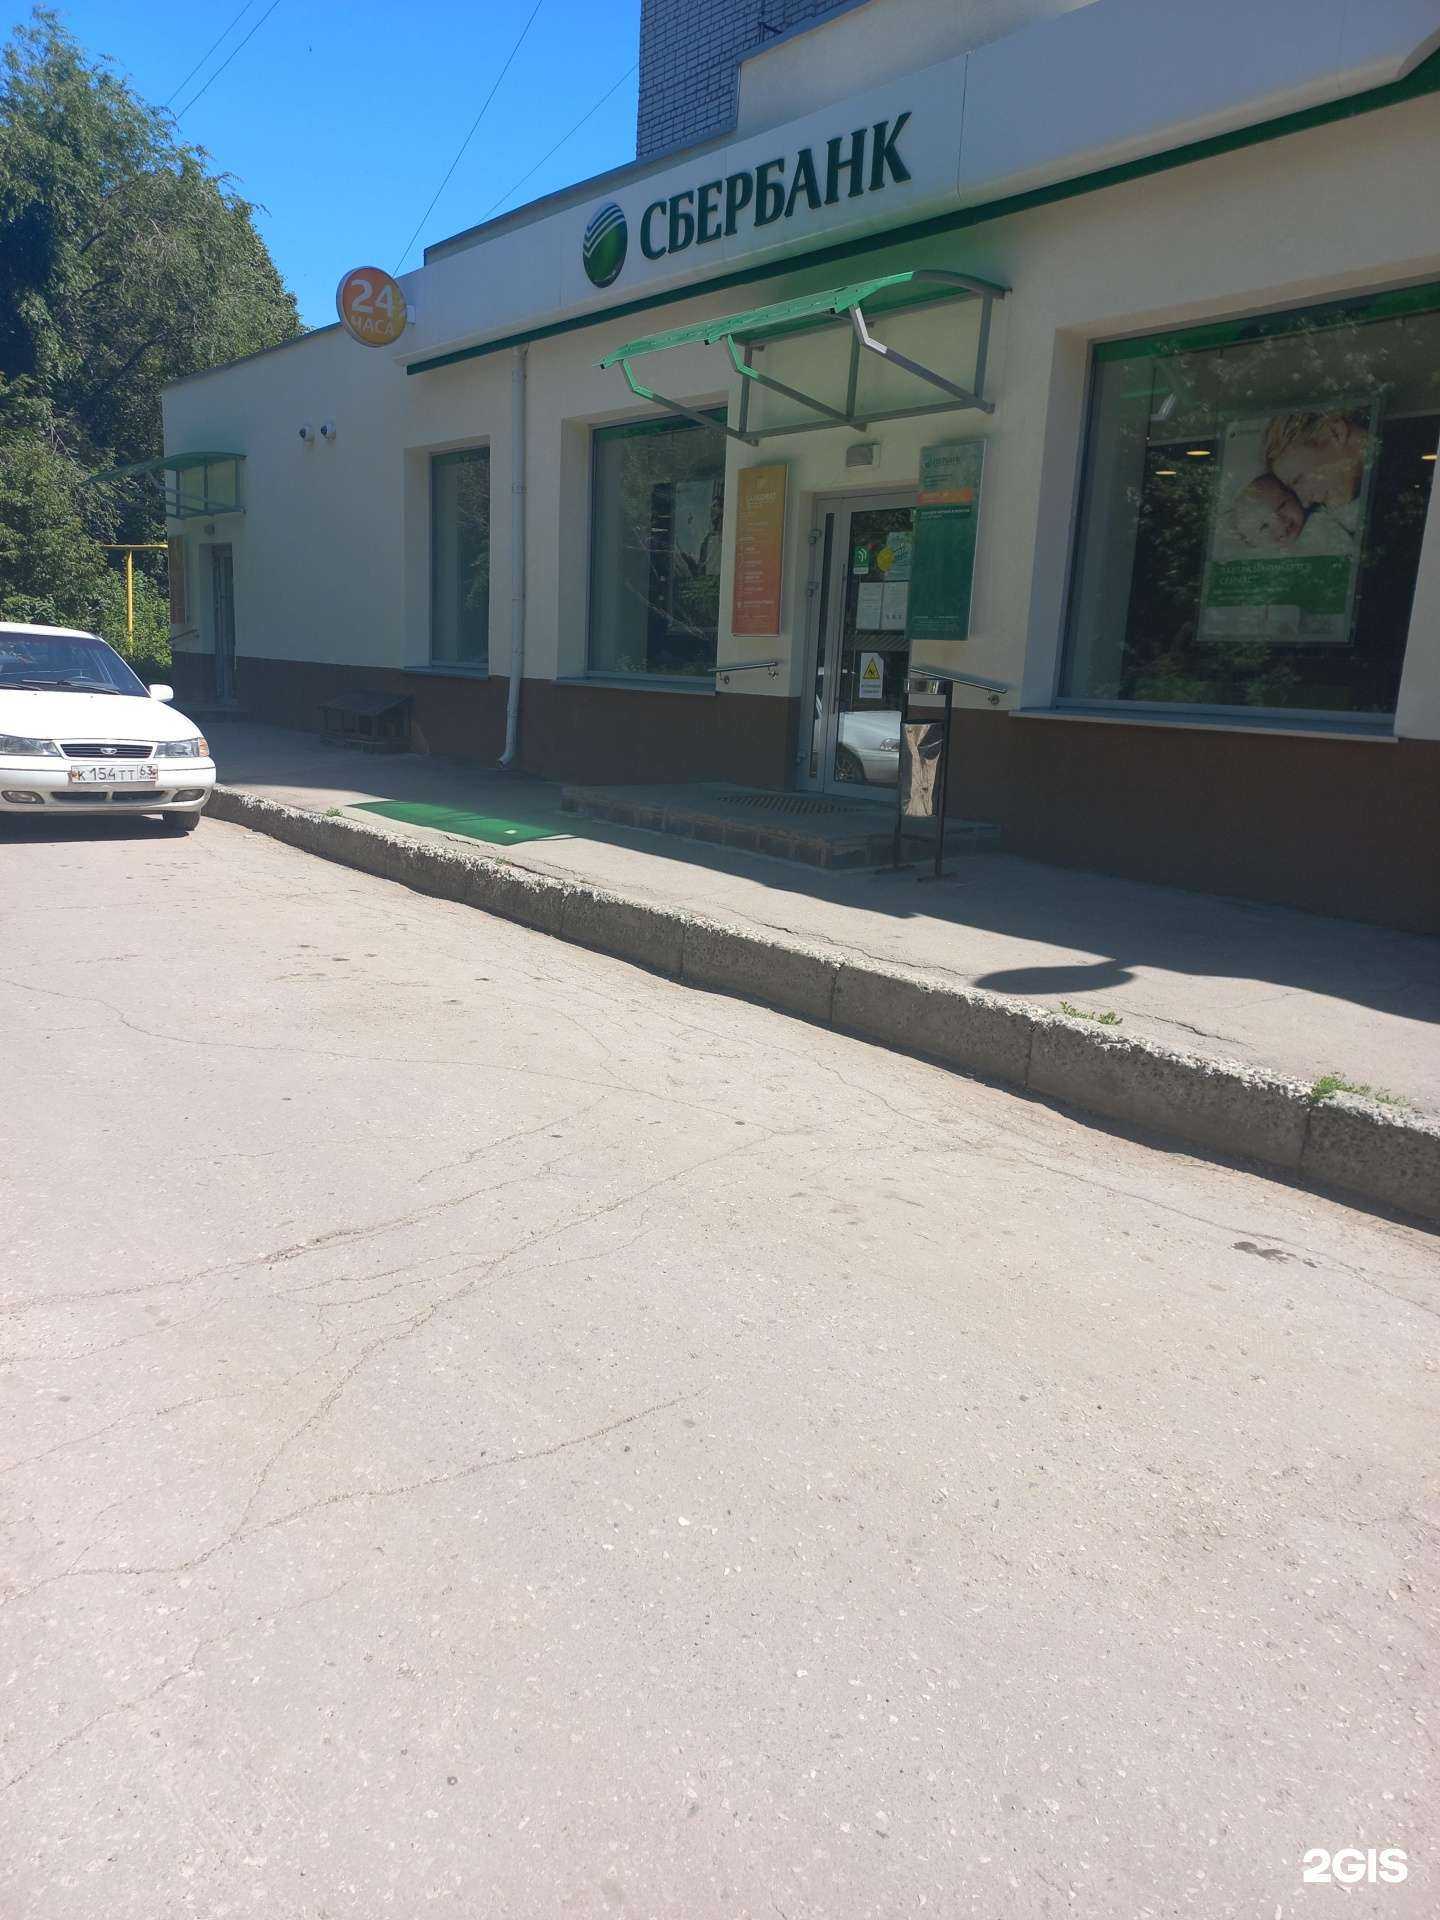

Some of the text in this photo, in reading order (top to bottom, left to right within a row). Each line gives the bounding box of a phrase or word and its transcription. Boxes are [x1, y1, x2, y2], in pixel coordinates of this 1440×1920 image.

[640, 111, 913, 260] СБЕРБАНК
[351, 279, 393, 320] 24
[350, 316, 395, 337] ЧАСА
